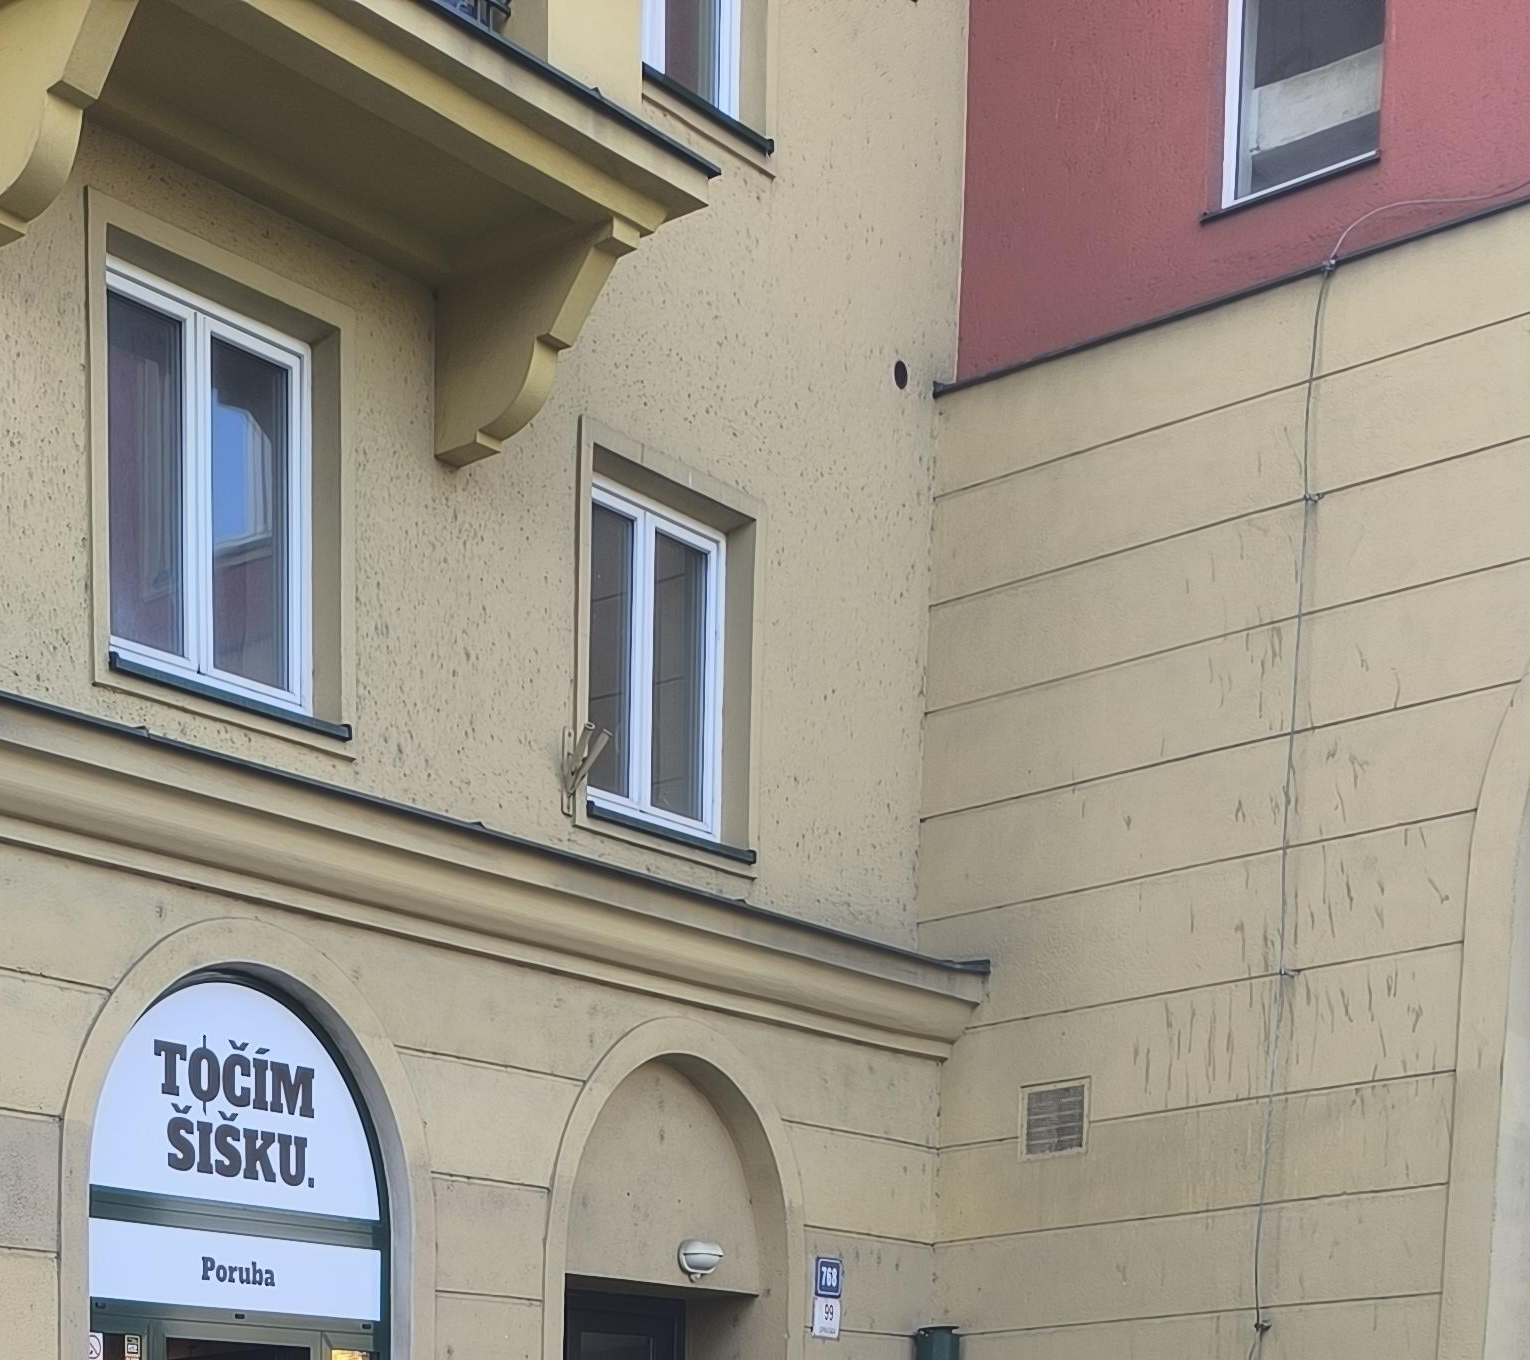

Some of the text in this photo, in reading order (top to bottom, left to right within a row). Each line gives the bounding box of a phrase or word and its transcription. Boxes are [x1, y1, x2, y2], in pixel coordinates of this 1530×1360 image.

[154, 1034, 315, 1119] TOČÍM
[166, 1102, 315, 1189] ŠIŠKU.
[201, 1256, 276, 1287] Poruba
[821, 1265, 837, 1288] 768
[824, 1303, 834, 1321] 99
